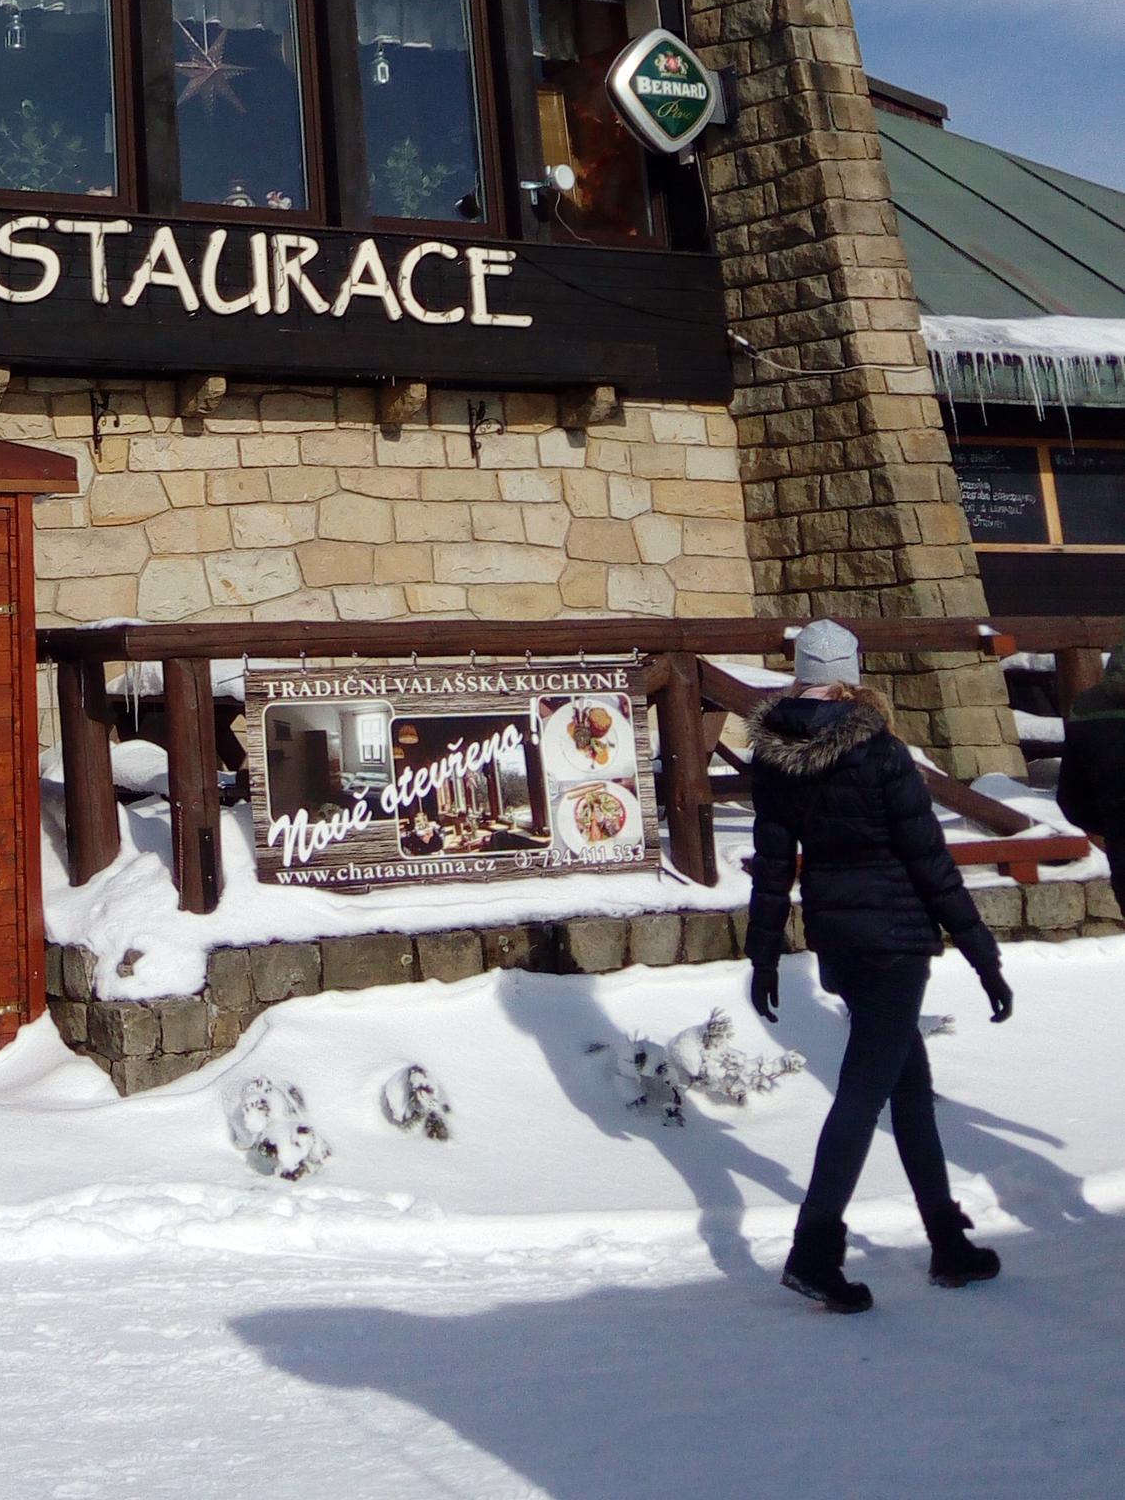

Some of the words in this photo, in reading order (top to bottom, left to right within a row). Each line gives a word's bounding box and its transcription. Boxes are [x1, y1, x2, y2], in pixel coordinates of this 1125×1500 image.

[636, 76, 707, 100] BERNARD
[262, 674, 388, 698] TRADIČNÍ
[393, 671, 510, 695] VALAŠSKÁ
[514, 668, 629, 691] KUCHYNĚ
[267, 786, 373, 868] Nově
[539, 848, 572, 868] 724
[578, 845, 607, 865] 411
[612, 844, 645, 863] 333
[275, 858, 497, 885] www.chatasumna.cz
